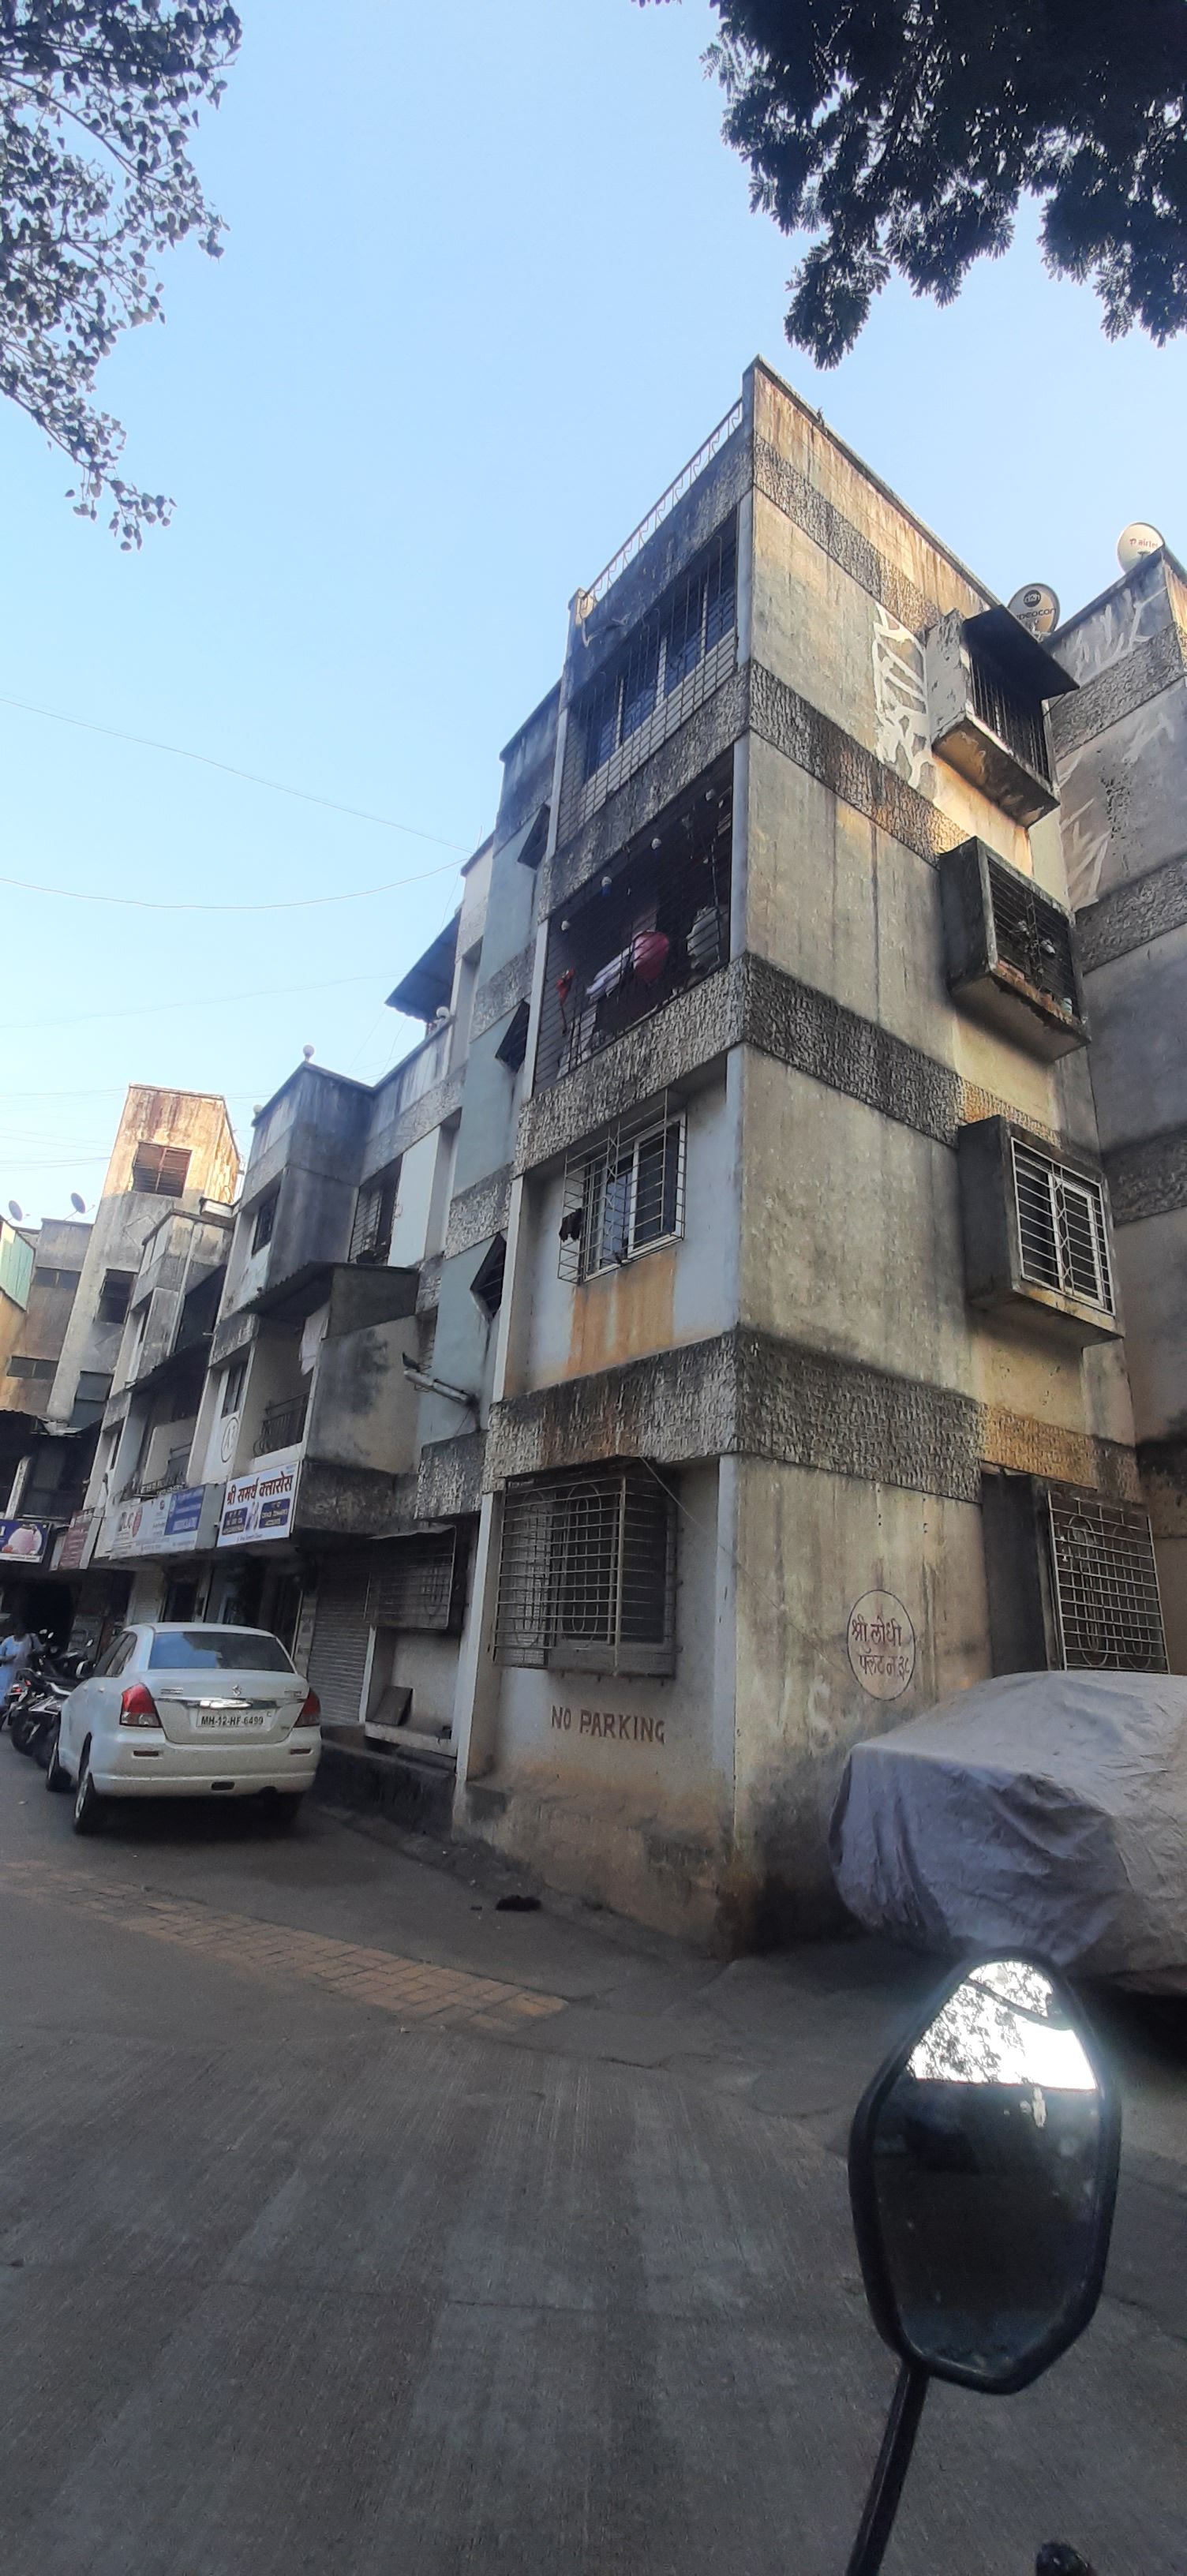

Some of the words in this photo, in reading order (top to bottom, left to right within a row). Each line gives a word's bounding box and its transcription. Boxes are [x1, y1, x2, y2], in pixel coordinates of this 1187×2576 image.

[1017, 608, 1056, 620] DEOCON
[852, 1613, 867, 1642] श्री
[871, 1615, 901, 1646] लोधी
[552, 1705, 571, 1730] NO
[580, 1709, 665, 1745] PARKING
